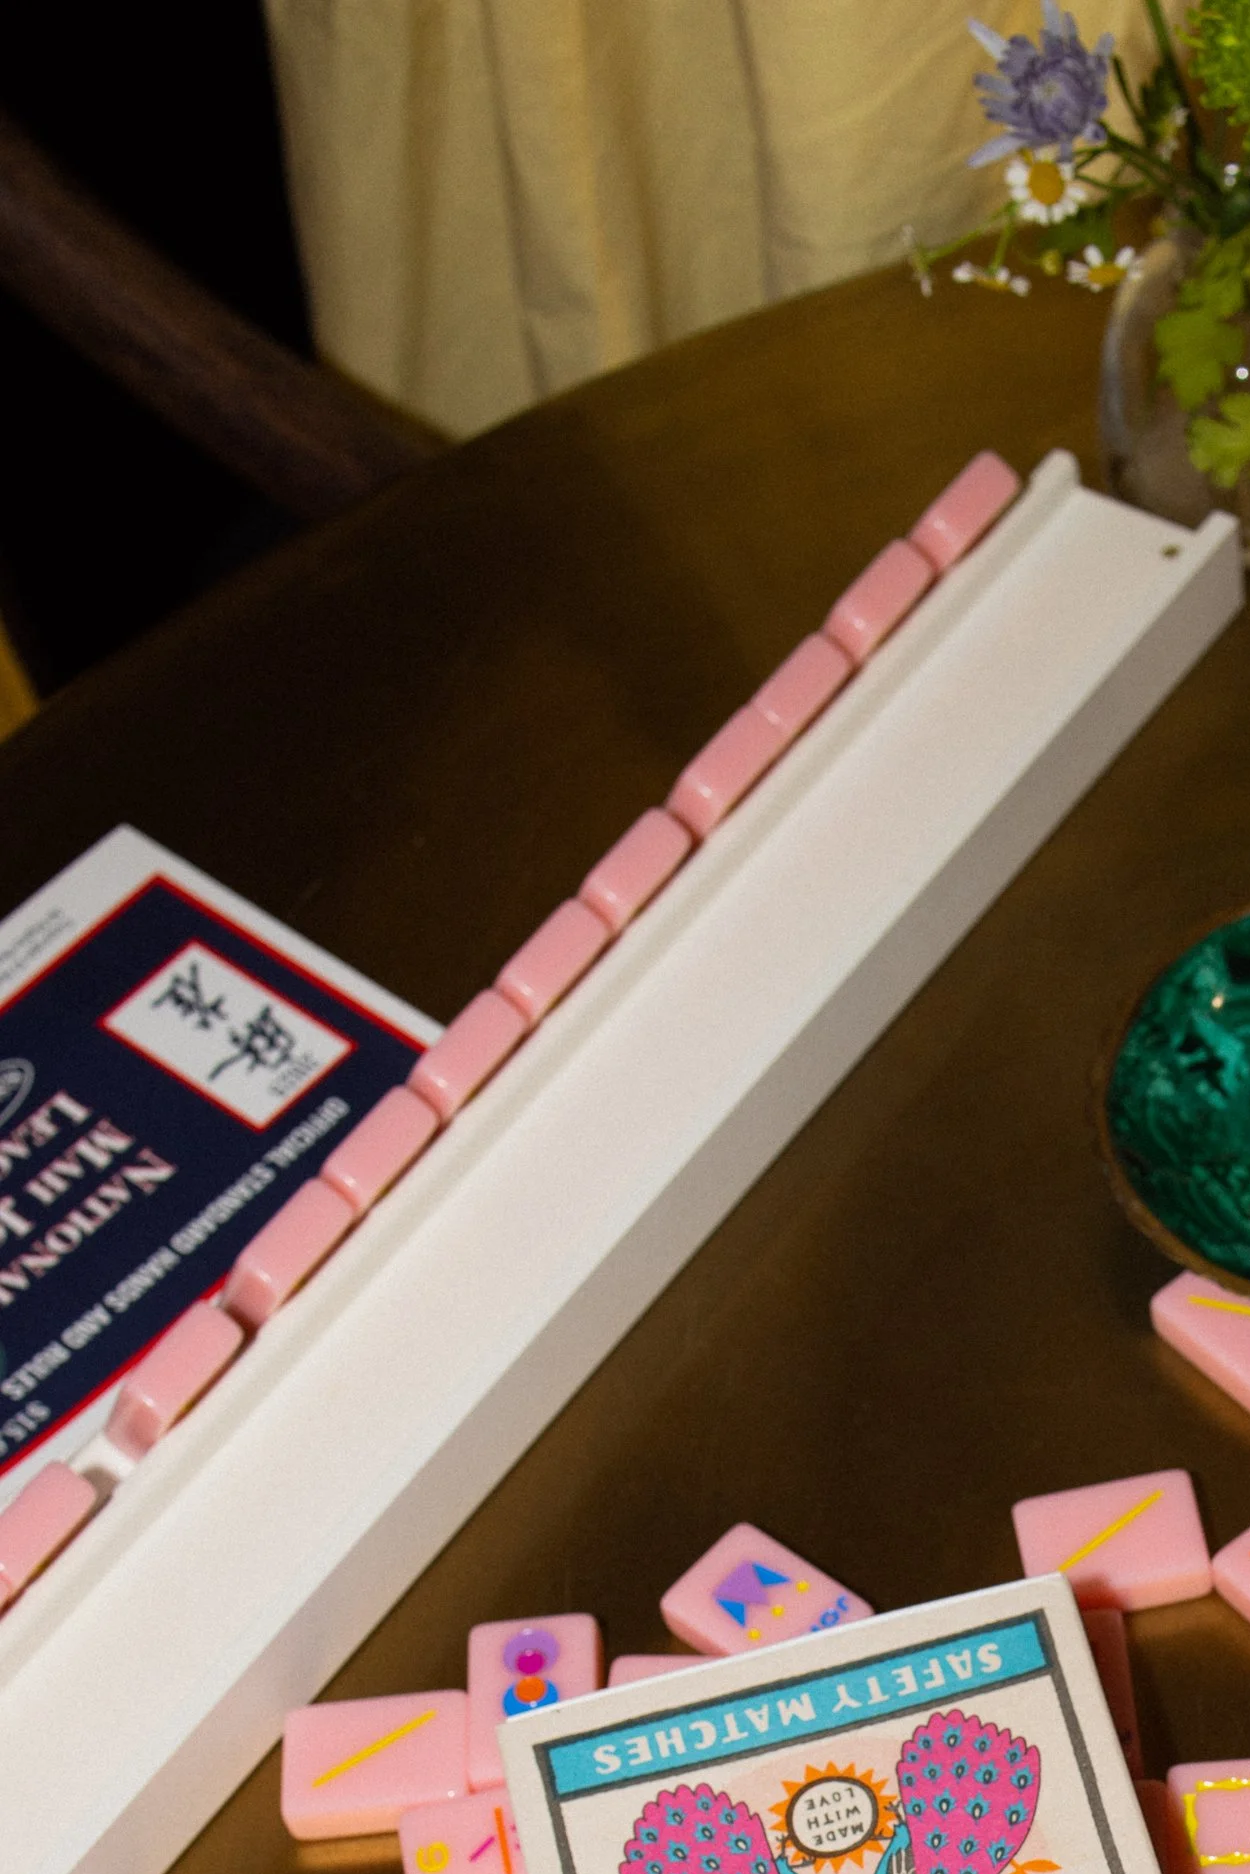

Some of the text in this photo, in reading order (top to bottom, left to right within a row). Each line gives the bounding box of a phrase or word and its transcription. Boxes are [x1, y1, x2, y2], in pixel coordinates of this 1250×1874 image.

[24, 1116, 137, 1206] MAH
[263, 1096, 349, 1168] OFFICIAL
[169, 1161, 278, 1255] STANDARD
[103, 1246, 181, 1313] HANDS
[61, 1303, 112, 1350] AND
[593, 1642, 1003, 1775] SAFETY MATCHES
[804, 1787, 855, 1810] LOVE
[806, 1806, 861, 1829] WITH
[812, 1822, 864, 1846] MADE
